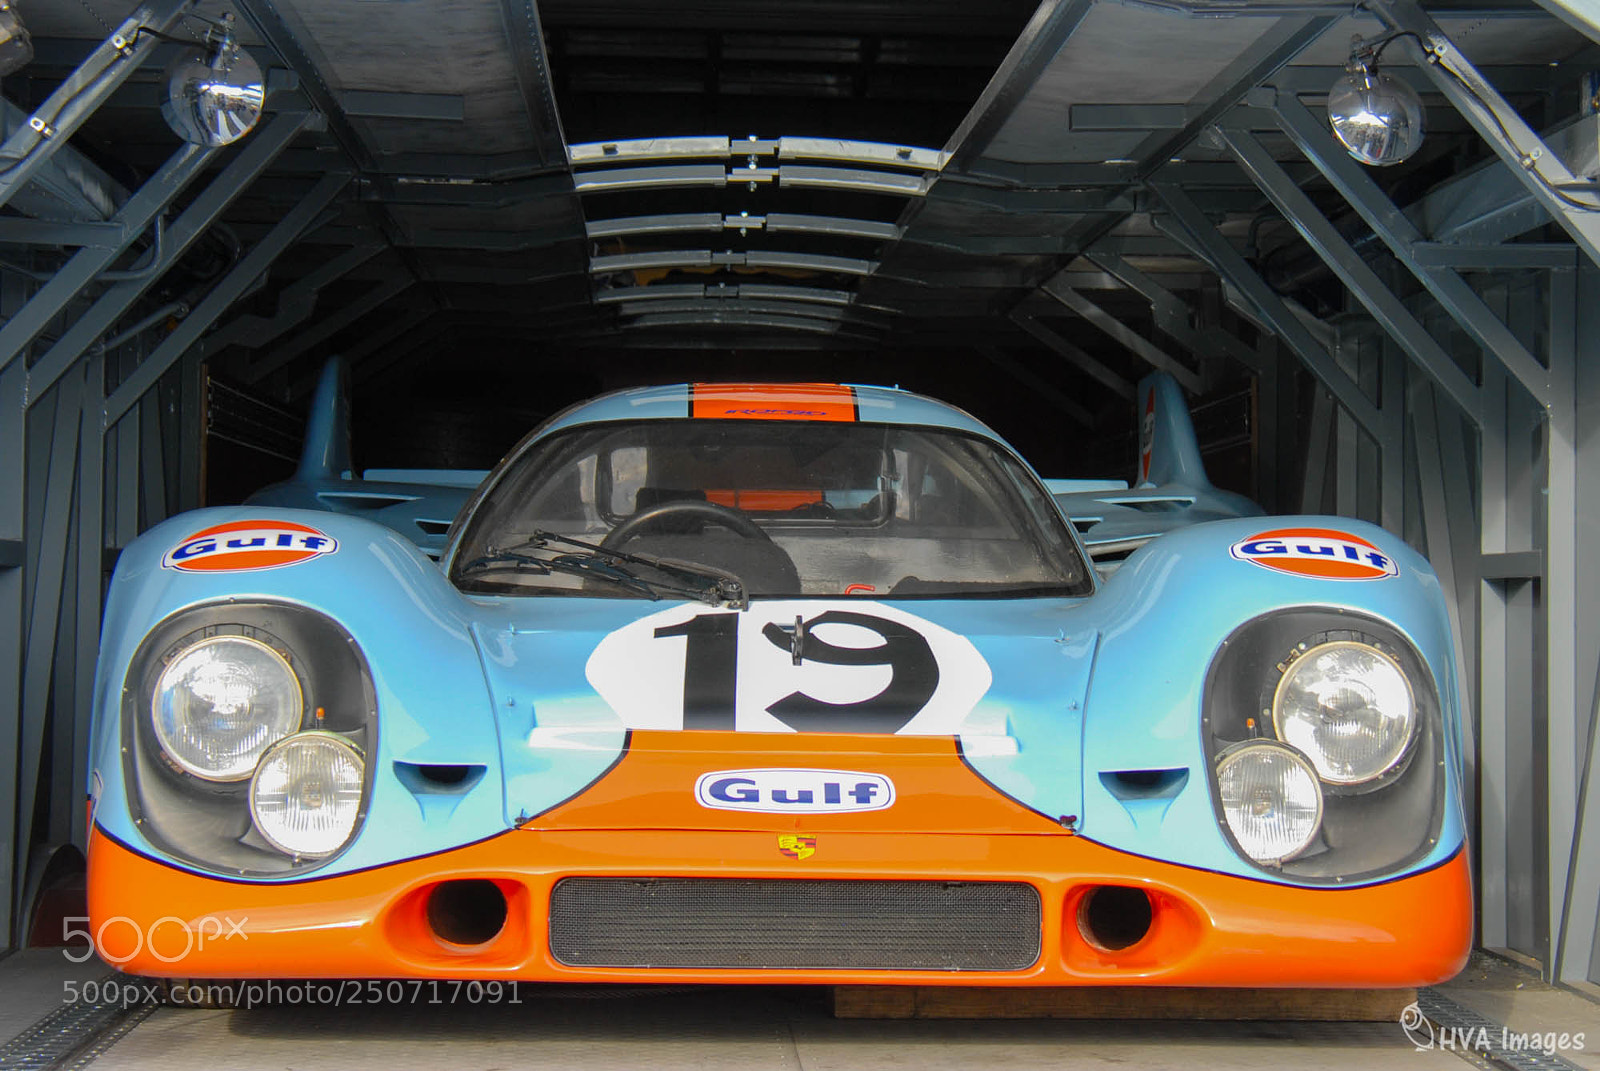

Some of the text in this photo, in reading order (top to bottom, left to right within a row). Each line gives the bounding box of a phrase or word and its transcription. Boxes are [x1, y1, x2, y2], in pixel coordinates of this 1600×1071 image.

[171, 534, 328, 560] Gulf
[1240, 540, 1389, 569] Gulf
[653, 610, 940, 734] 19
[708, 777, 879, 804] Gulf
